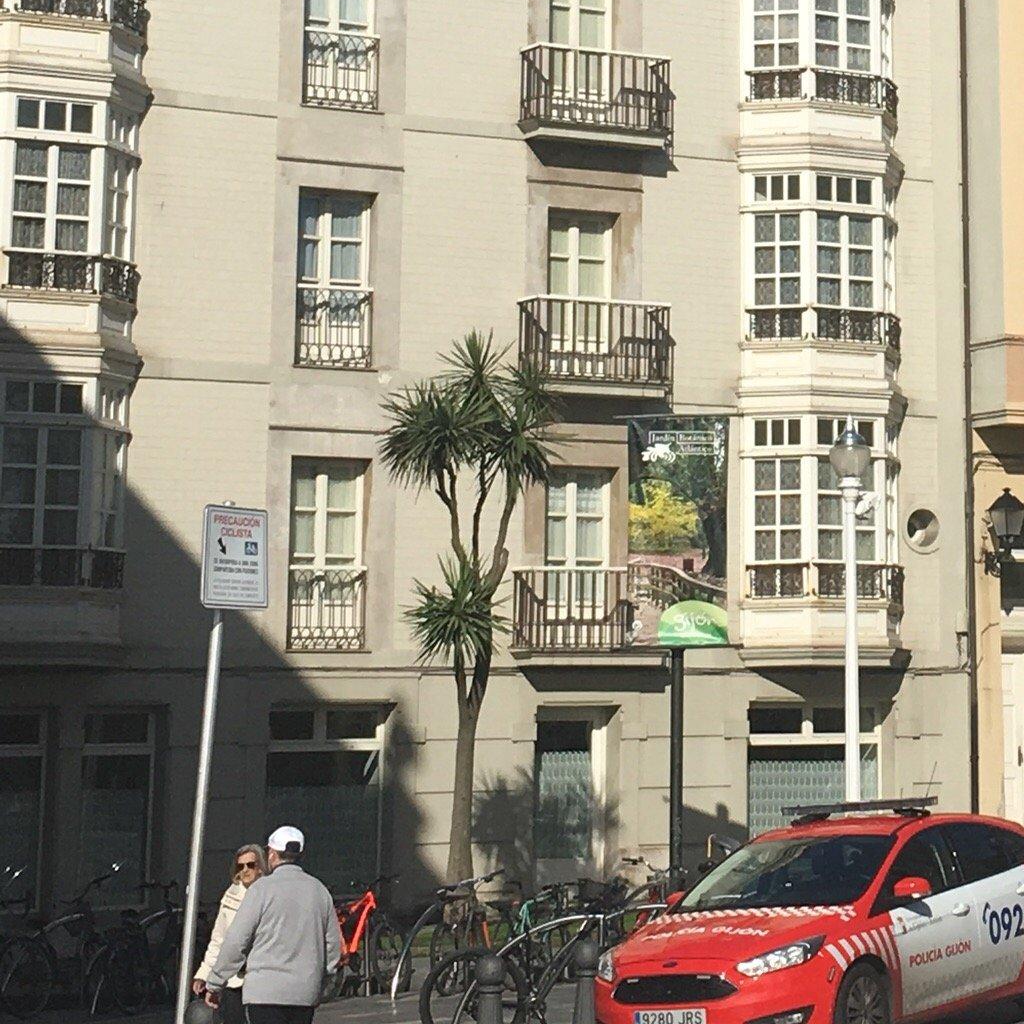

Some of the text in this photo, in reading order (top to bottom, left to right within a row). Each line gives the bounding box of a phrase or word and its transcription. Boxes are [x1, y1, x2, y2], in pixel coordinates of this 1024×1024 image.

[220, 527, 252, 538] CICLISTA
[642, 1010, 703, 1024] 9280 JRS
